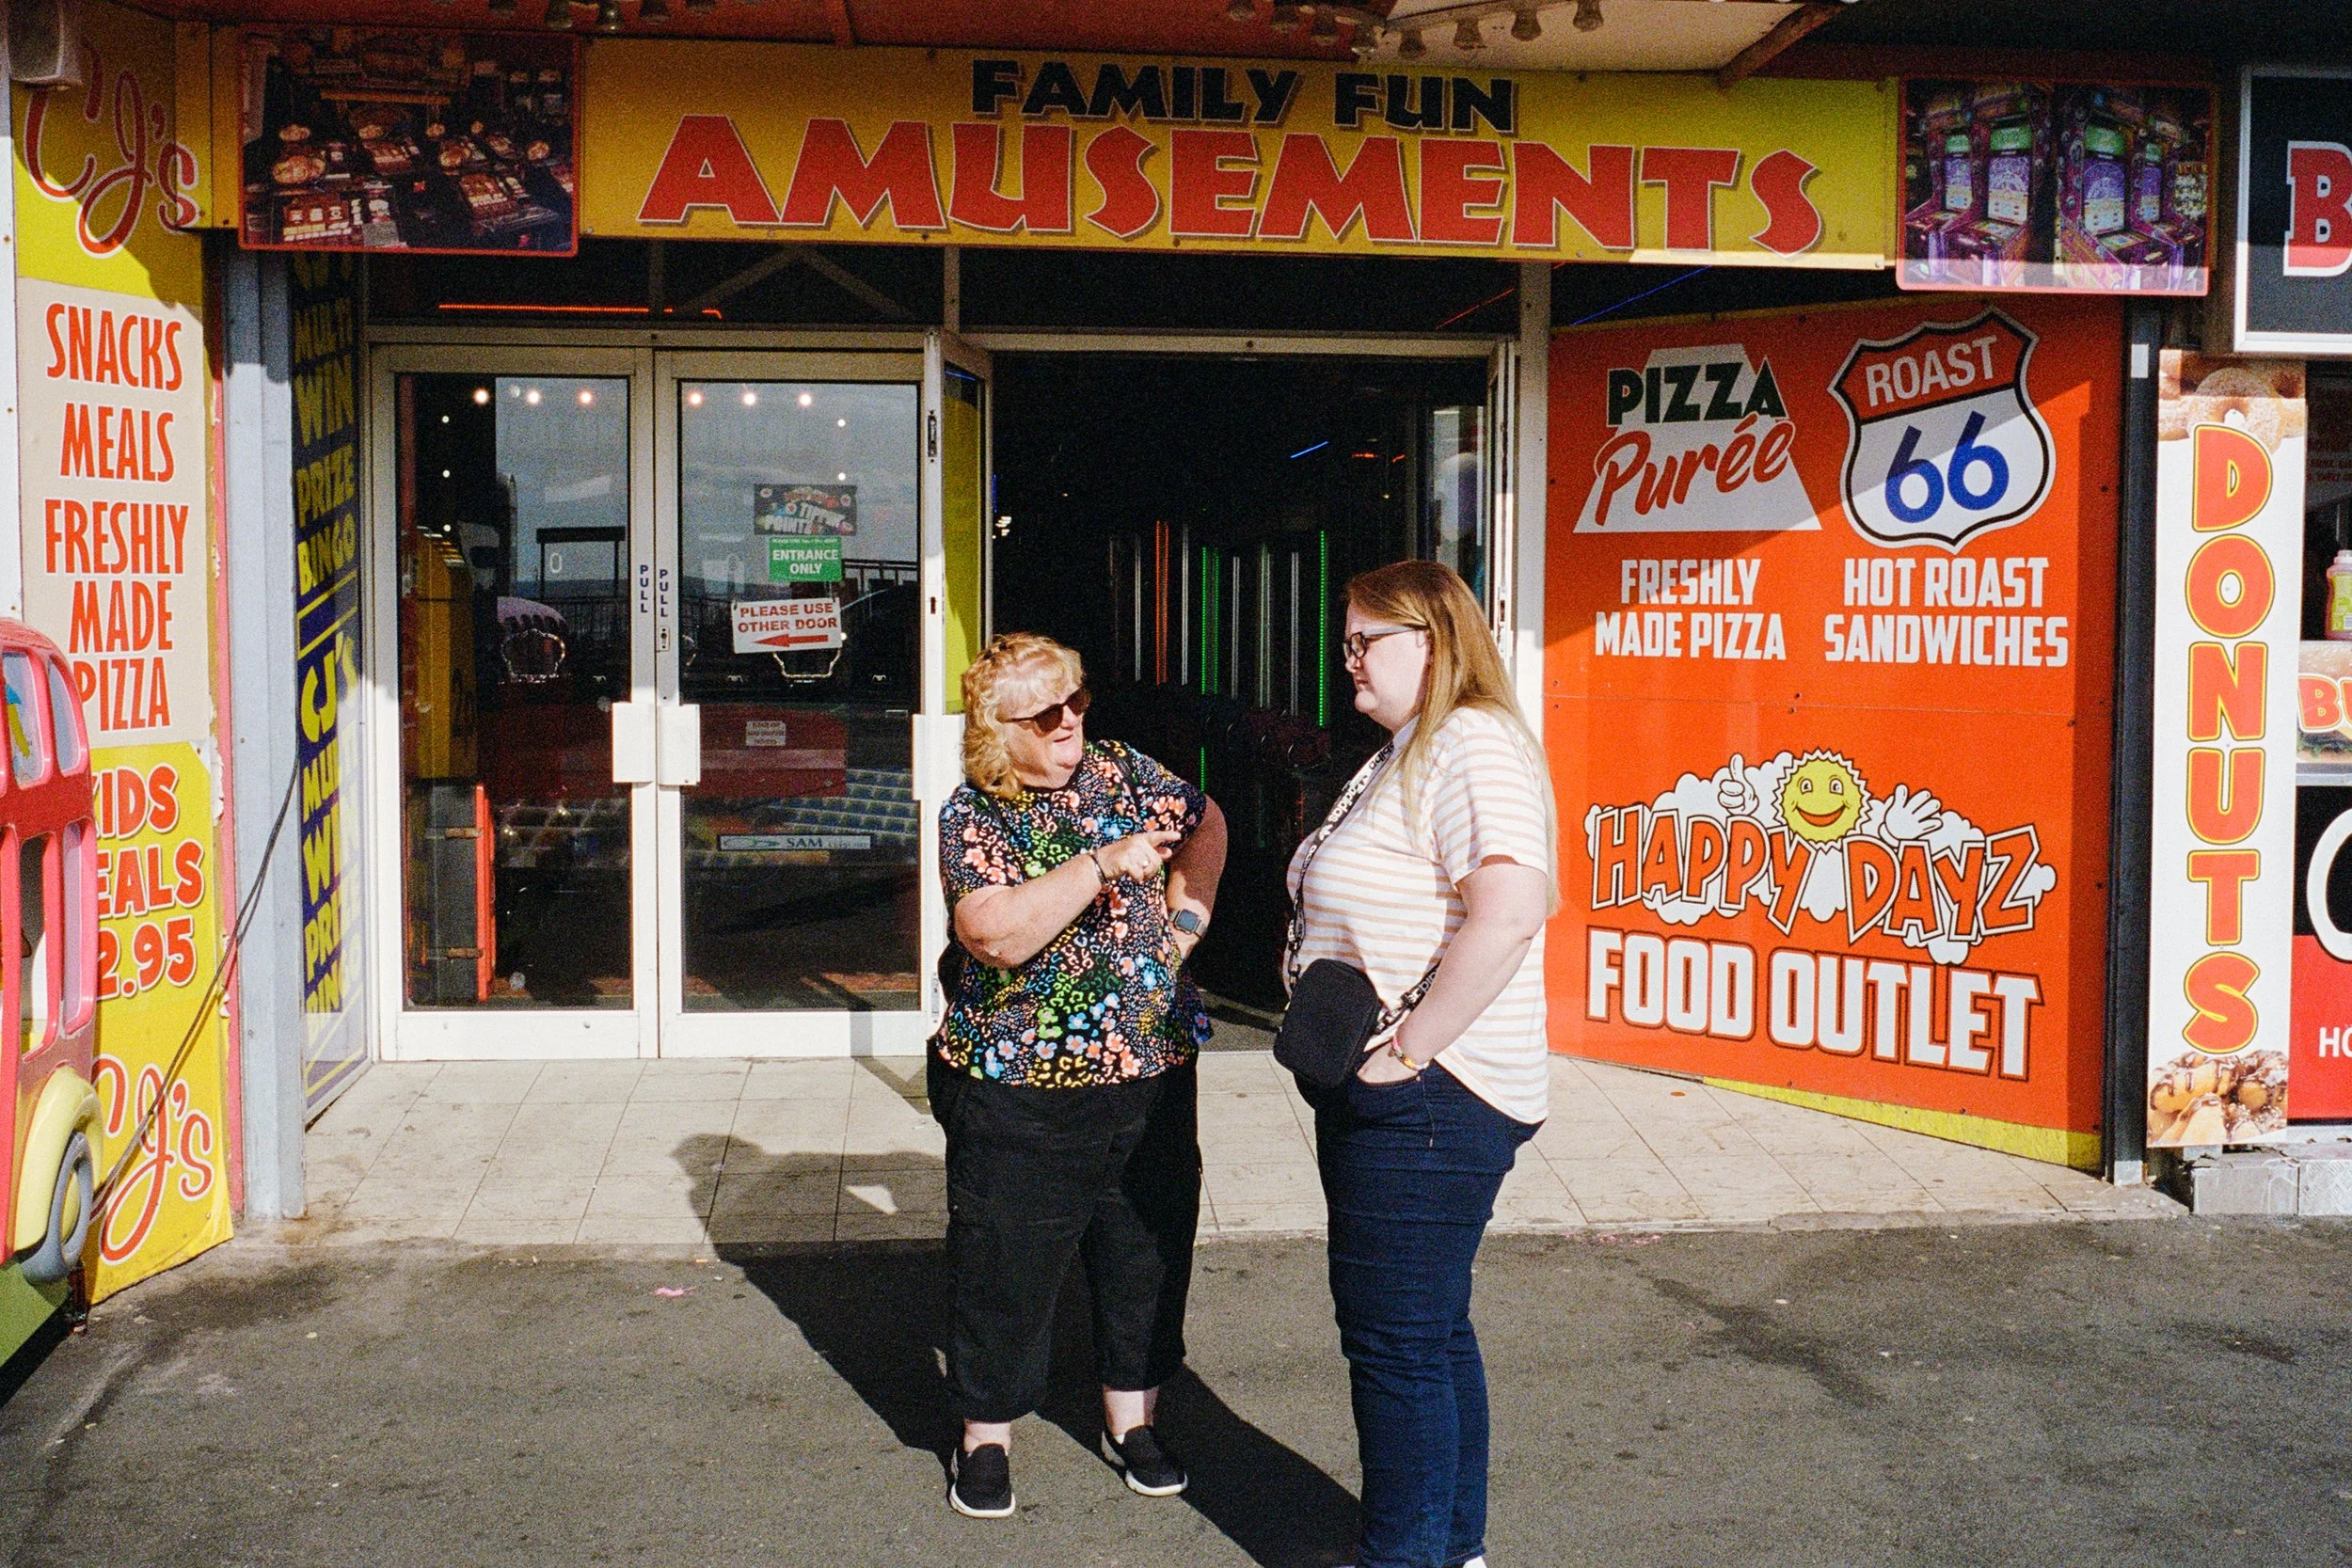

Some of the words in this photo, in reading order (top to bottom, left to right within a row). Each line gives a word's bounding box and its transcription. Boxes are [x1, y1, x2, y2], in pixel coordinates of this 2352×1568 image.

[972, 60, 1302, 126] FAMILY
[1333, 71, 1518, 134] FUN
[637, 114, 1824, 258] AMUSEMENTS
[46, 303, 182, 392] SNACKS
[1867, 337, 1998, 408] ROAST
[295, 355, 355, 448] WIN
[1607, 356, 1788, 428] PIZZA
[60, 403, 174, 483] MEALS
[1593, 414, 1796, 528] Purée
[1884, 410, 2010, 523] 66
[296, 444, 355, 529] PRIZE
[44, 499, 188, 574] FRESHLY
[297, 512, 356, 596] BINGO
[771, 548, 839, 562] ENTRANCE
[788, 562, 823, 575] ONLY
[69, 580, 174, 654] MADE
[640, 564, 649, 613] PULL
[659, 568, 669, 618] PULL
[739, 605, 800, 619] PLEASE
[804, 602, 834, 614] USE
[1621, 558, 1761, 606] FRESHLY
[1844, 558, 1916, 607] HOT
[1924, 557, 2050, 607] ROAST
[738, 620, 791, 634] OTHER
[795, 617, 838, 631] DOOR
[1596, 611, 1684, 658] MADE
[1692, 612, 1787, 661] PIZZA
[1824, 614, 2069, 669] SANDWICHES
[72, 657, 171, 732] PIZZA
[2183, 425, 2276, 1054] DONUTS
[96, 839, 205, 920] EALS
[1590, 804, 1817, 937] HAPPY
[1843, 825, 2041, 944] DAYZ
[1586, 926, 1757, 1041] FOOD
[1769, 946, 2044, 1082] OUTLET
